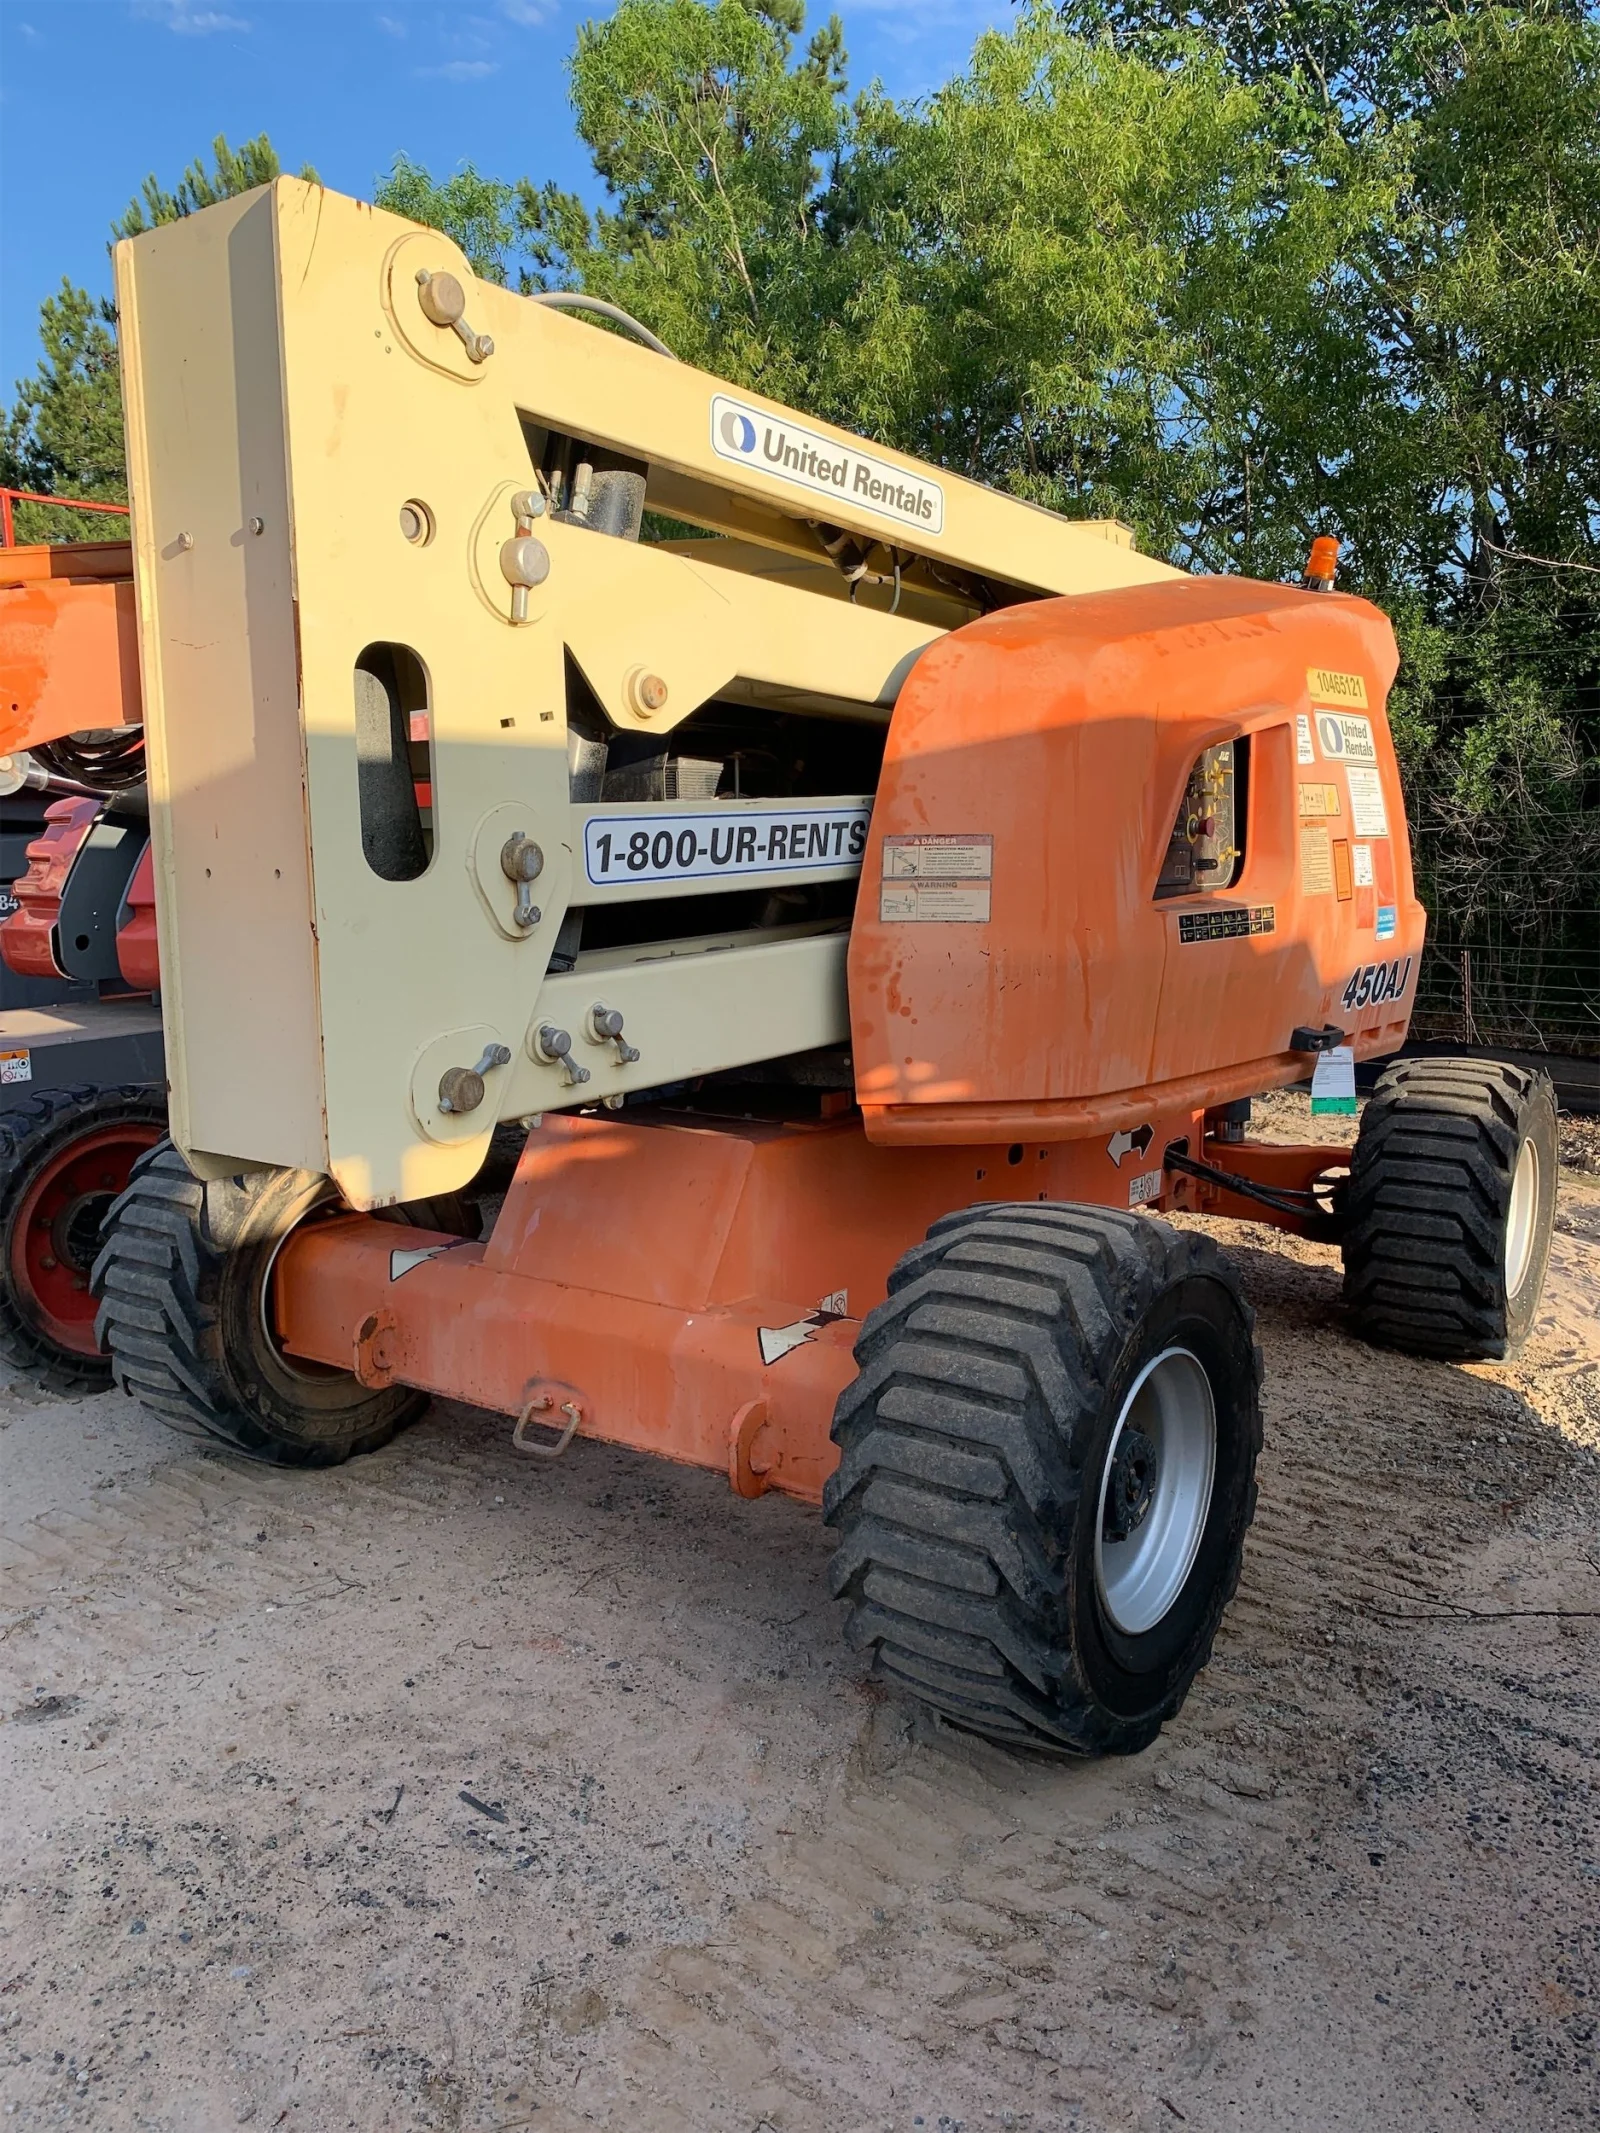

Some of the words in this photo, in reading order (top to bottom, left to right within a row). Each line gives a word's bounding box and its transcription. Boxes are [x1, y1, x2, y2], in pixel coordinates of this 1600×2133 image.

[763, 428, 848, 488] United
[853, 464, 933, 520] Rentals
[1317, 672, 1362, 697] 10465121
[1340, 720, 1367, 739] United
[1345, 738, 1373, 757] Rentals
[596, 820, 867, 873] 1-800-UR-RENTS
[1341, 957, 1412, 1011] 450AJ
